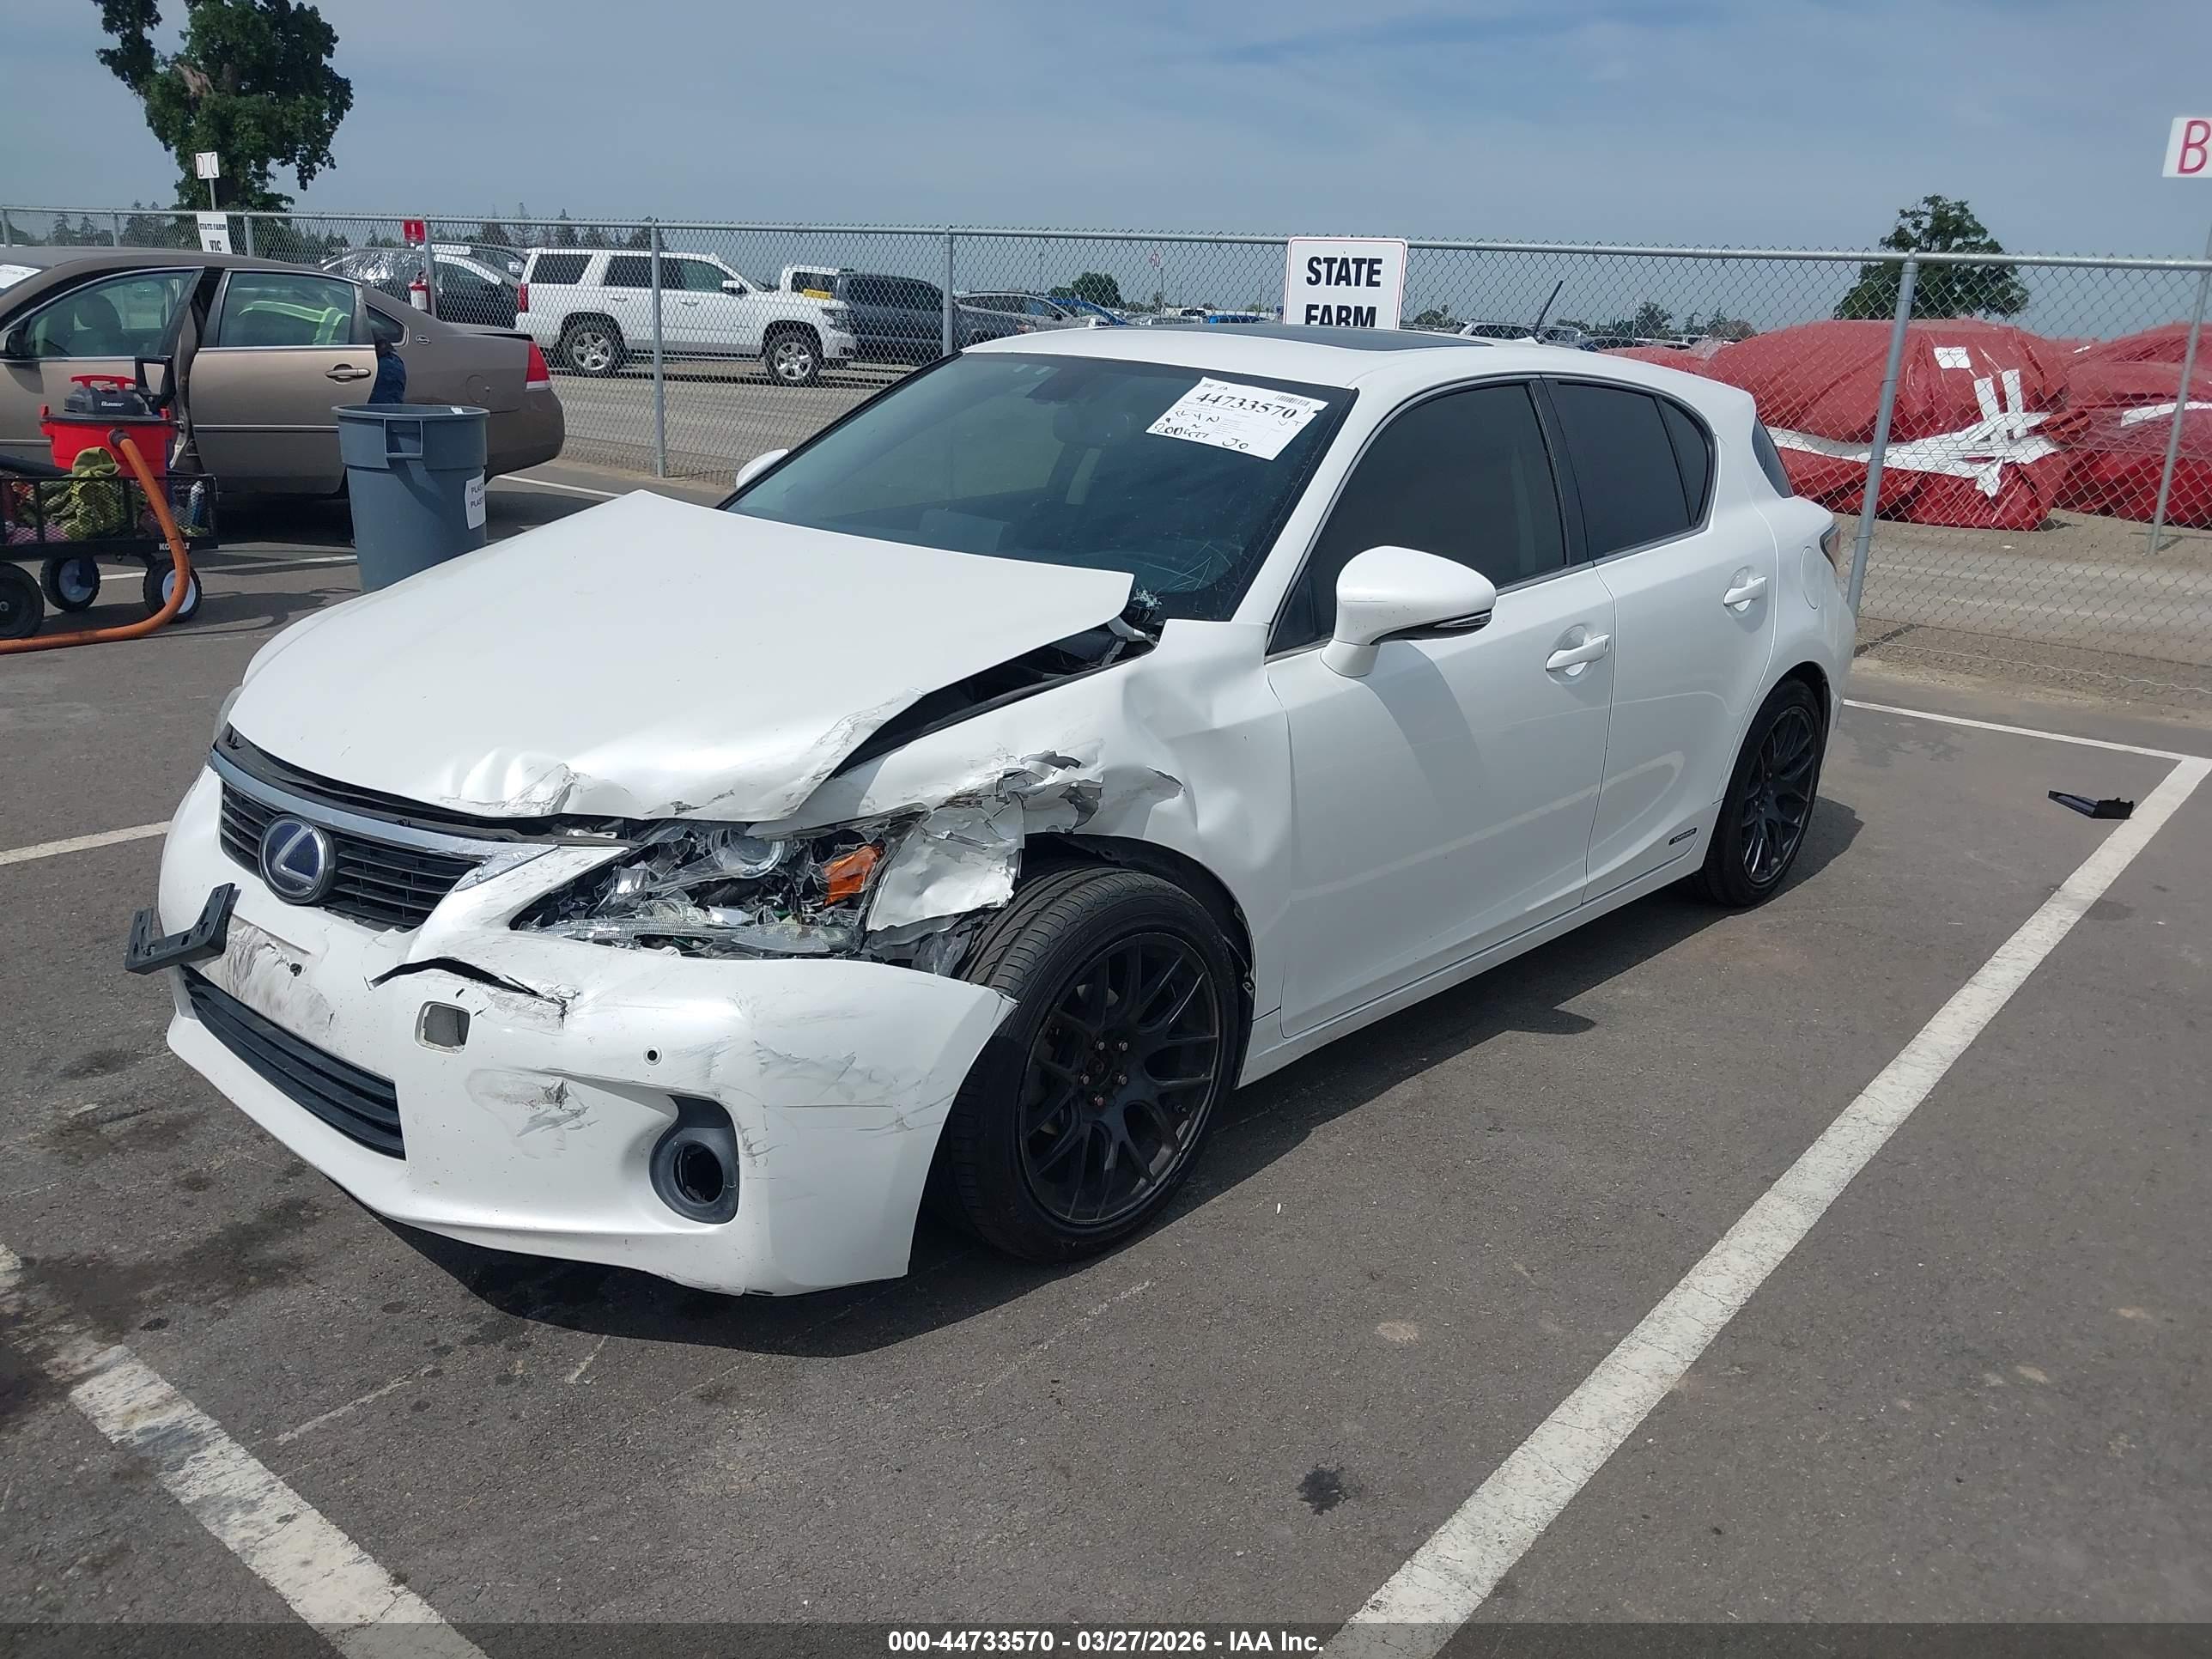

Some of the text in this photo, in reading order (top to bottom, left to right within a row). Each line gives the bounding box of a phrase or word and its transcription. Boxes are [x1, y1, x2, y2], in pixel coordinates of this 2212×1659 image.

[209, 240, 222, 252] VIC
[1306, 256, 1382, 288] STATE
[1305, 303, 1377, 327] FARM
[1195, 392, 1297, 420] 44733570
